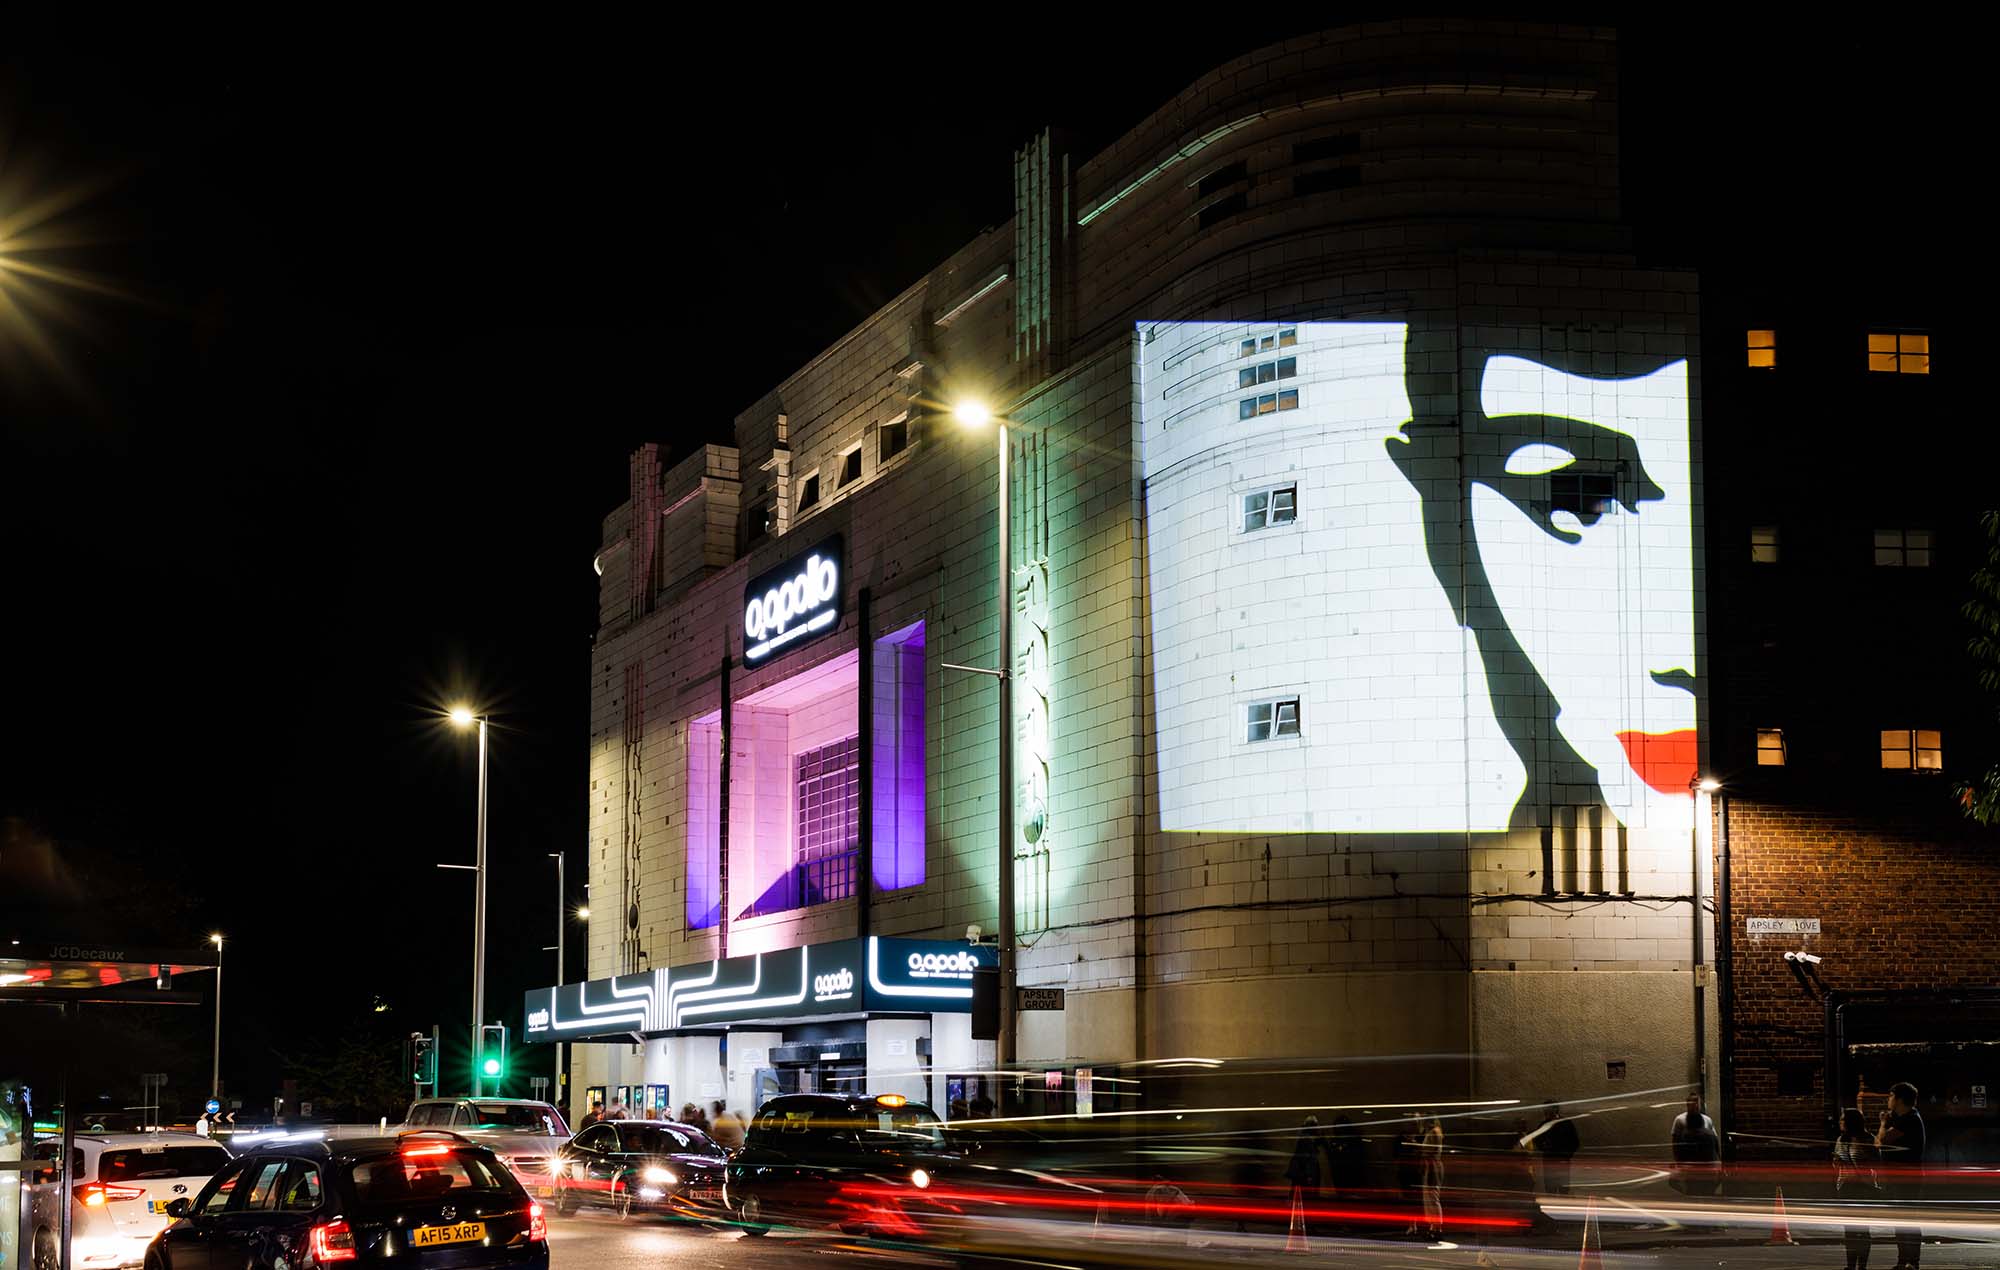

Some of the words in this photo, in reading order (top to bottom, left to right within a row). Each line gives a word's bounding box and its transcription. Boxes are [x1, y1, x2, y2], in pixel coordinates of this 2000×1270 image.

[1750, 920, 1784, 930] APSLEY
[48, 946, 125, 960] JCDecaux
[1023, 990, 1059, 1000] APSLEY
[1025, 1000, 1057, 1009] GROVE
[420, 1227, 451, 1243] AF15
[453, 1225, 480, 1240] XRP
